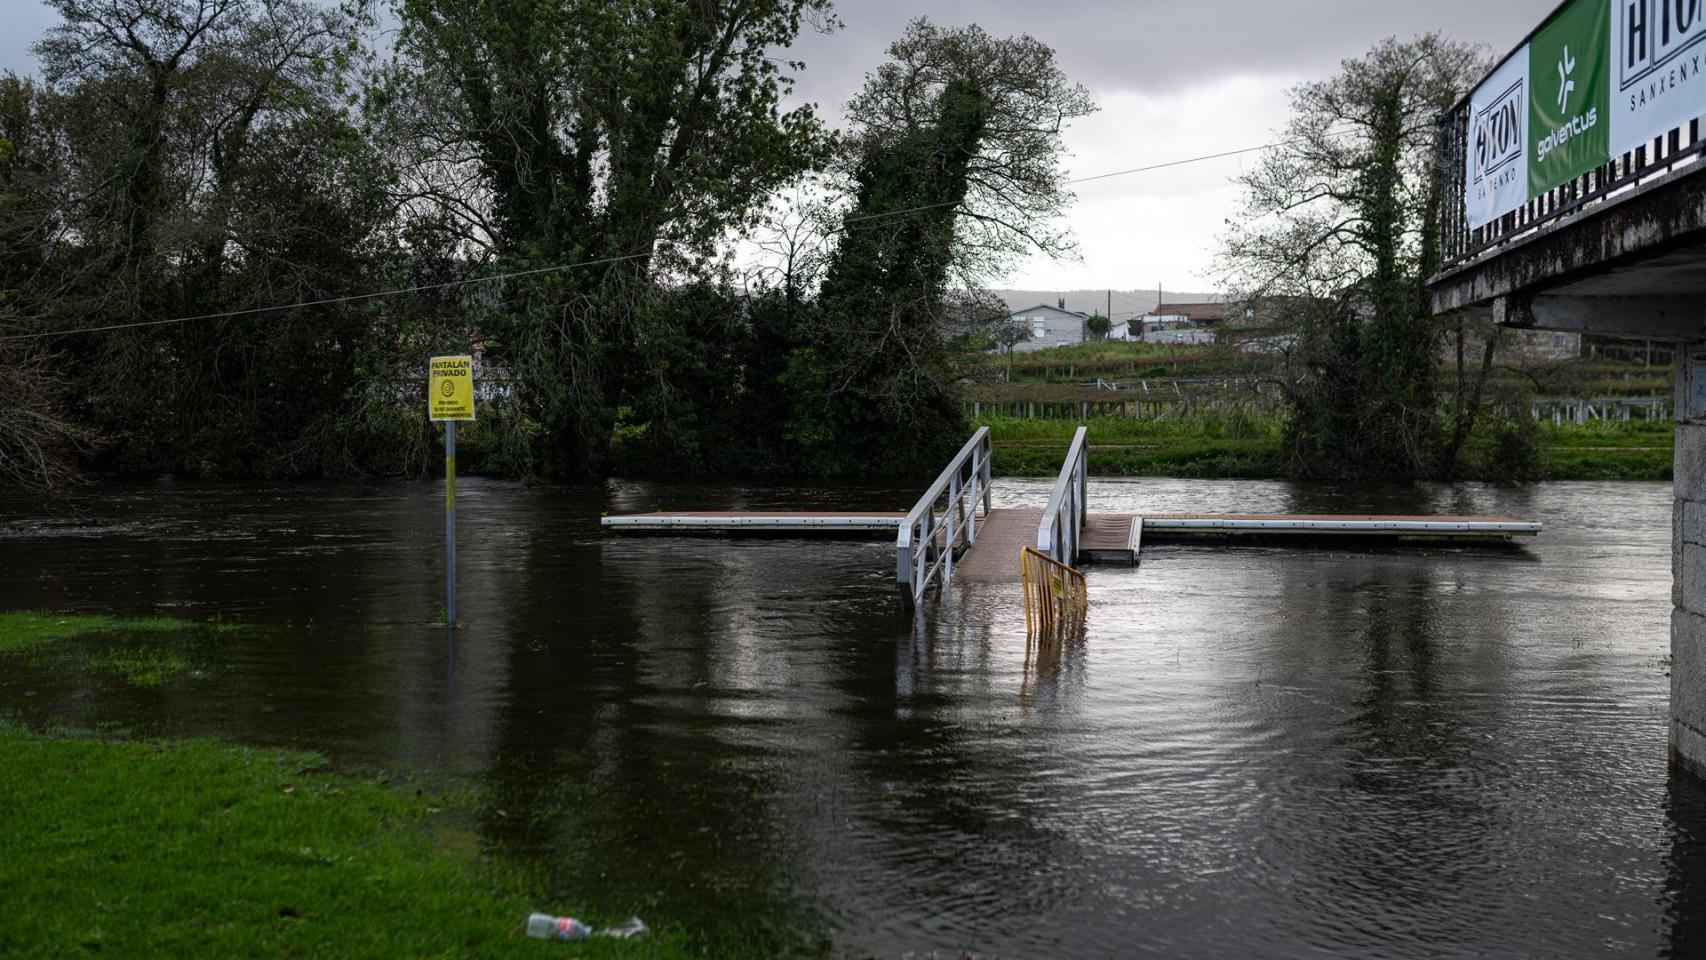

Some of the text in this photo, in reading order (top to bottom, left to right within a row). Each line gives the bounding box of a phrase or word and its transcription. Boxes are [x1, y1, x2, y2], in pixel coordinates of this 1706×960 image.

[1630, 53, 1706, 112] SANXENX
[1537, 106, 1597, 162] galventus
[433, 369, 467, 377] PRIVADO
